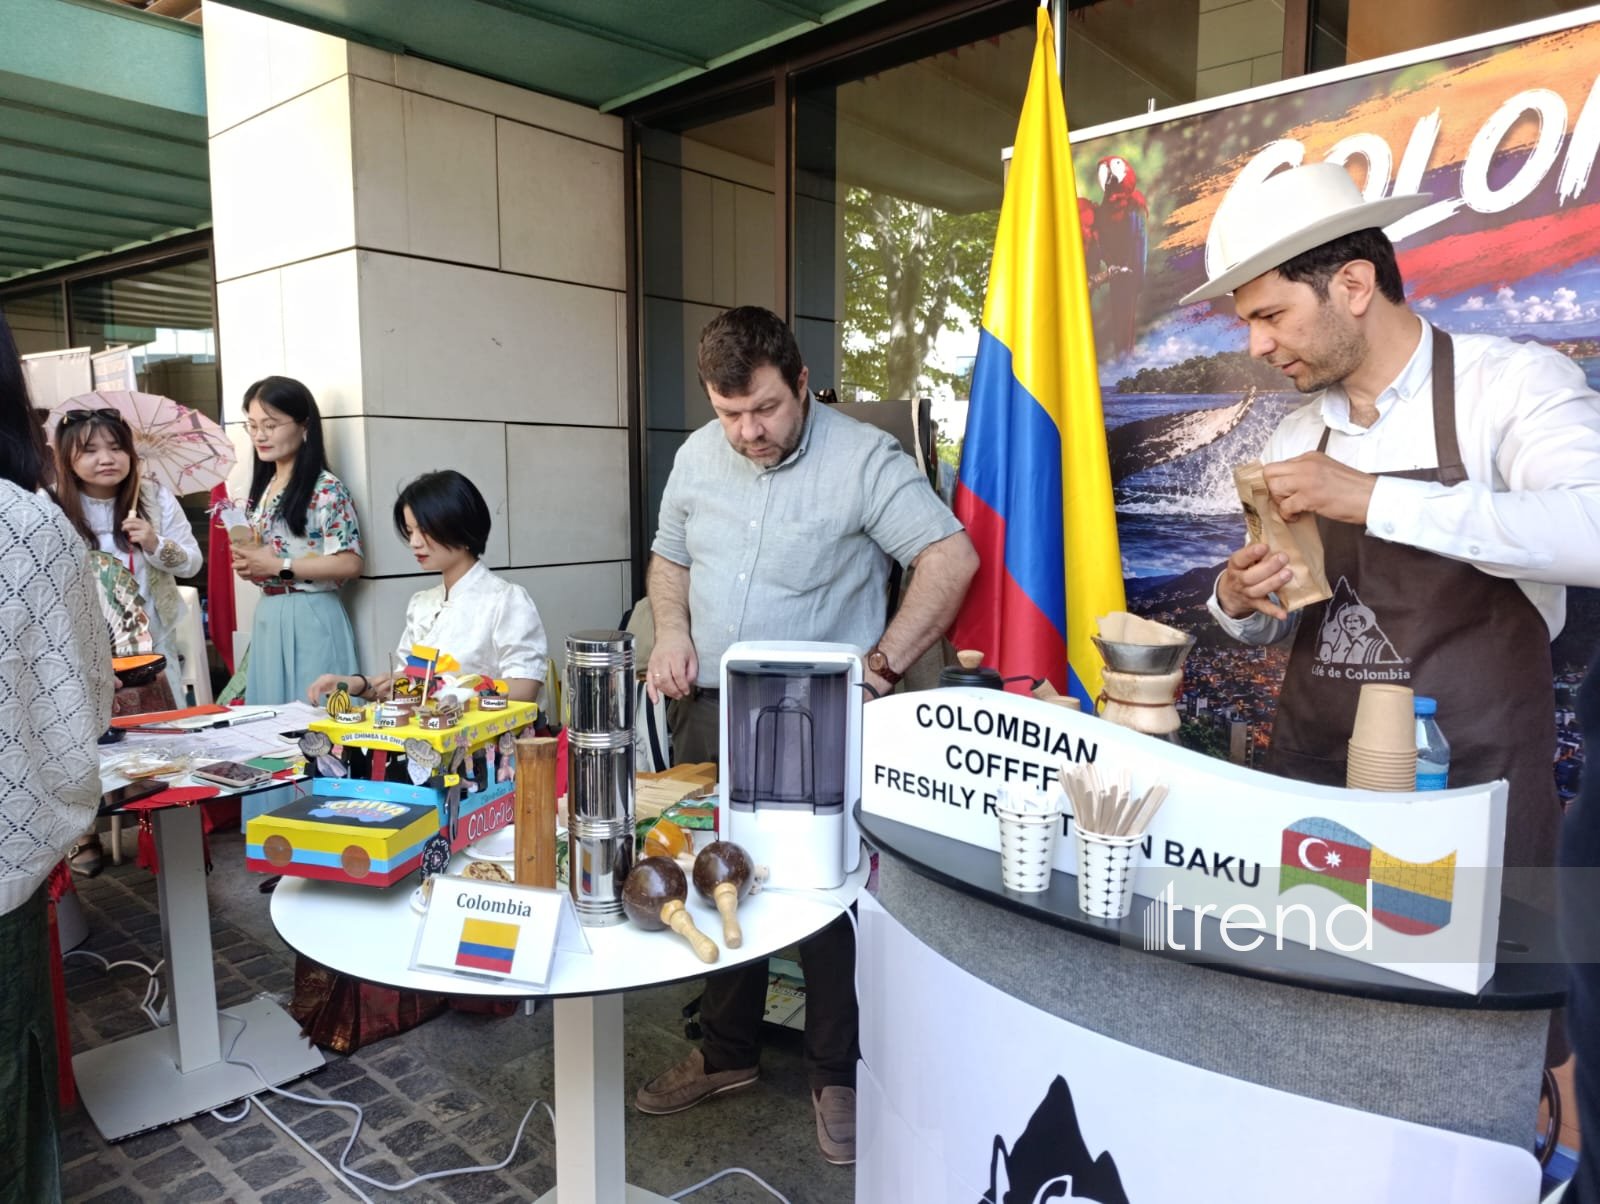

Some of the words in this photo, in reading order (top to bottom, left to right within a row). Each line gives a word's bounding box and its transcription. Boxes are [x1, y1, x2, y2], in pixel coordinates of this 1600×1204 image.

[1205, 73, 1600, 297] COLO
[1328, 667, 1341, 679] de
[1345, 667, 1411, 681] Colombia
[389, 736, 406, 747] CHIV
[916, 703, 1099, 764] COLOMBIAN
[328, 799, 407, 818] CHIVA
[874, 764, 976, 810] FRESHLY
[1164, 839, 1262, 889] BAKU
[455, 892, 532, 917] Colombia
